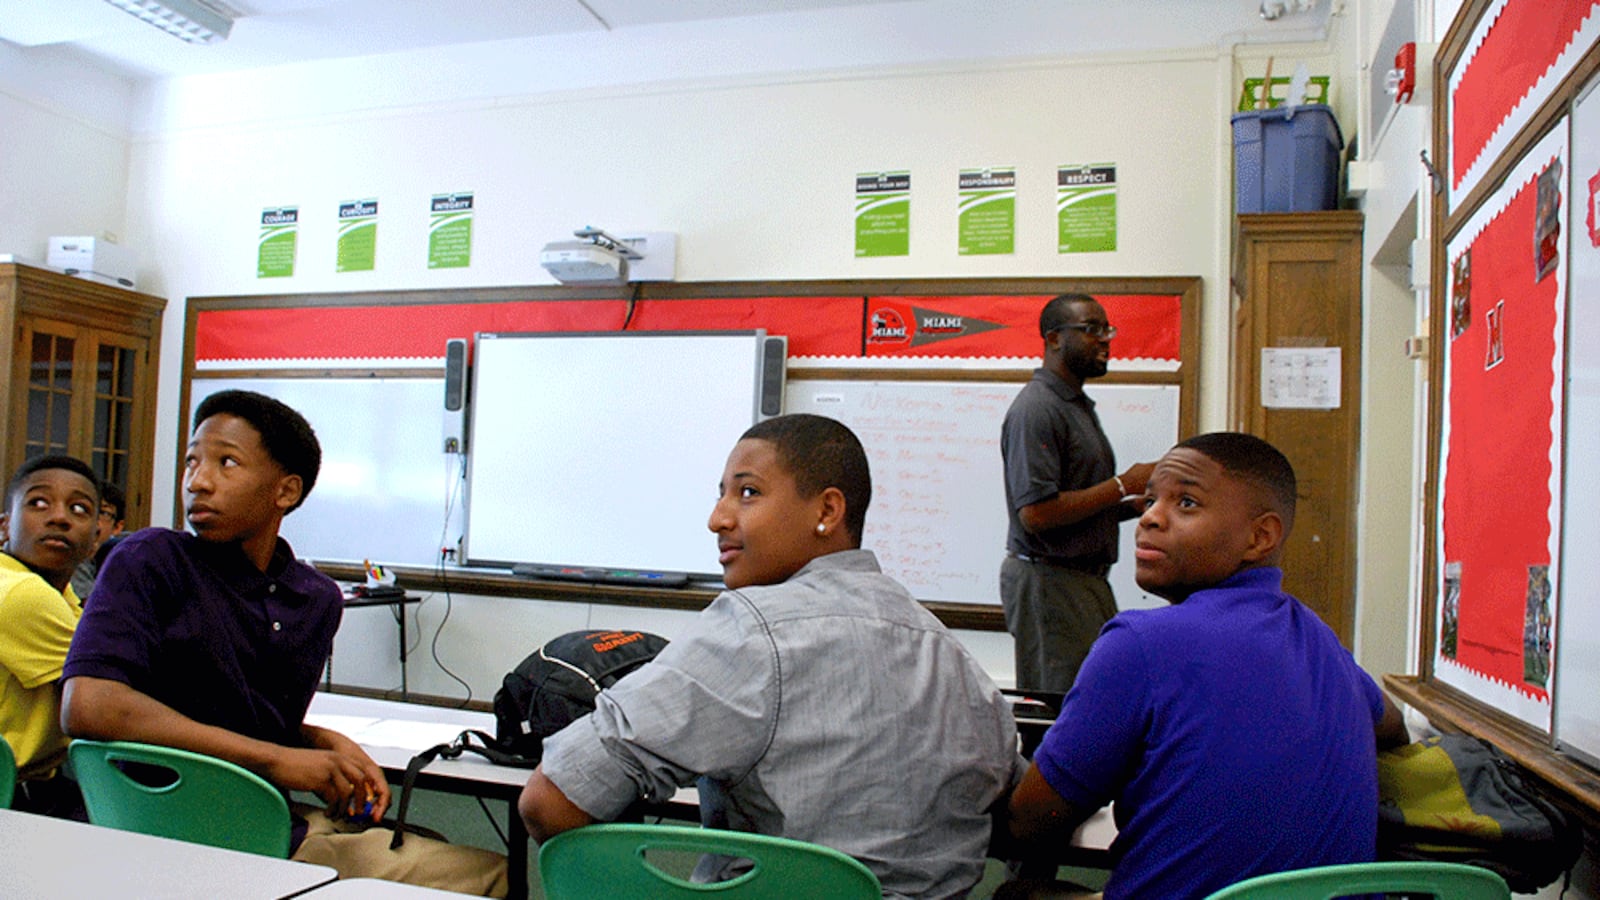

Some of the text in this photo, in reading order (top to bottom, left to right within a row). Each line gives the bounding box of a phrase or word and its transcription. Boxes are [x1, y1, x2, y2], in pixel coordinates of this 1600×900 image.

[1066, 174, 1107, 184] RESPECT
[434, 201, 470, 211] INTEGRITY
[923, 317, 963, 328] MIAMI
[872, 327, 907, 337] MIAMI
[1484, 298, 1505, 372] M
